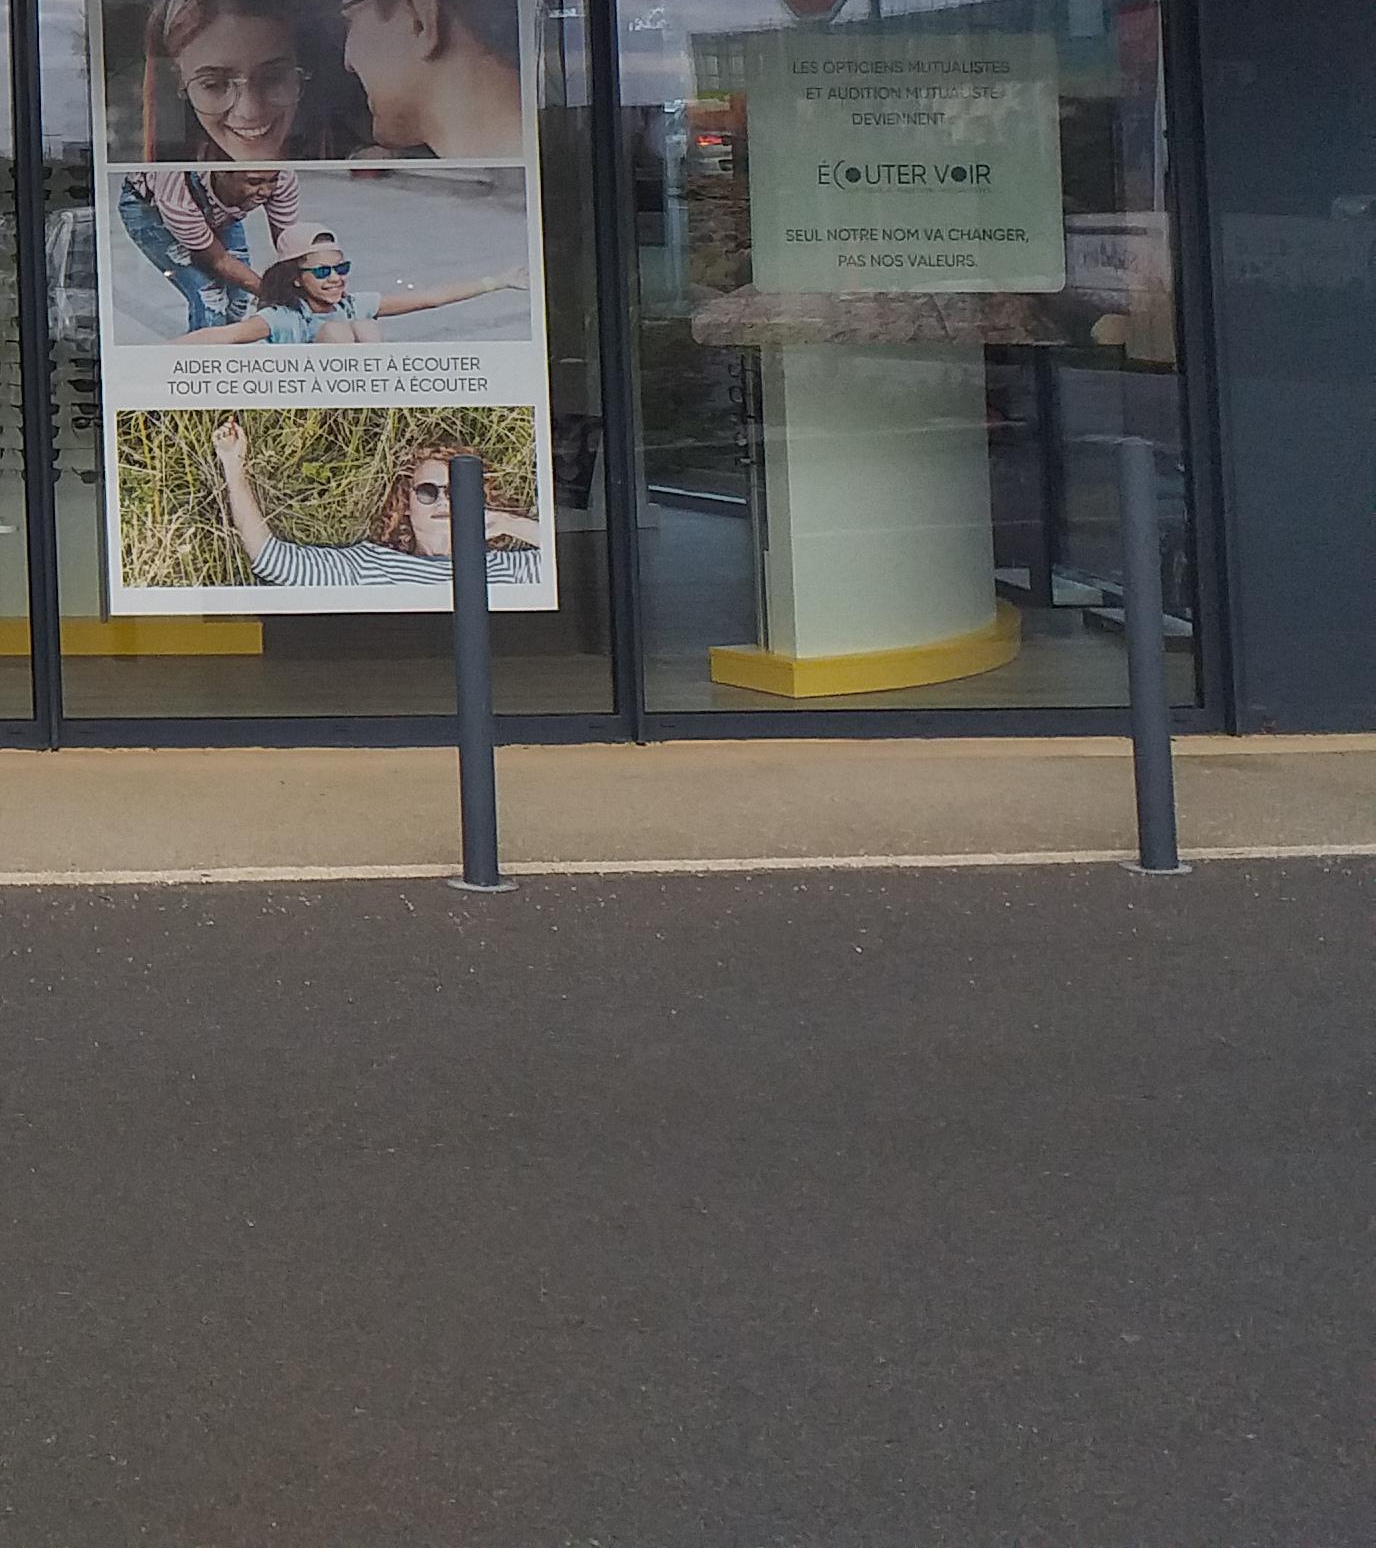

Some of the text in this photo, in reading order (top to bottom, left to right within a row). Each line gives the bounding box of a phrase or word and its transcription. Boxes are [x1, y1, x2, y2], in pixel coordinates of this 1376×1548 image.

[792, 60, 1011, 75] LES OPTICIENS MUTUALISTES
[805, 87, 823, 100] ET
[827, 86, 902, 100] AUDITION
[934, 164, 992, 185] VOIR
[785, 226, 1030, 245] SEUL NOTRE NOM VA CHANGER,
[837, 252, 979, 269] PAS NOS VALEURS.
[172, 353, 481, 374] AIDER CHACUN À VOIR ET À ÉCOUTER
[166, 375, 488, 396] TOUT CE QUI EST À VOIR ET À ÉCOUTER
